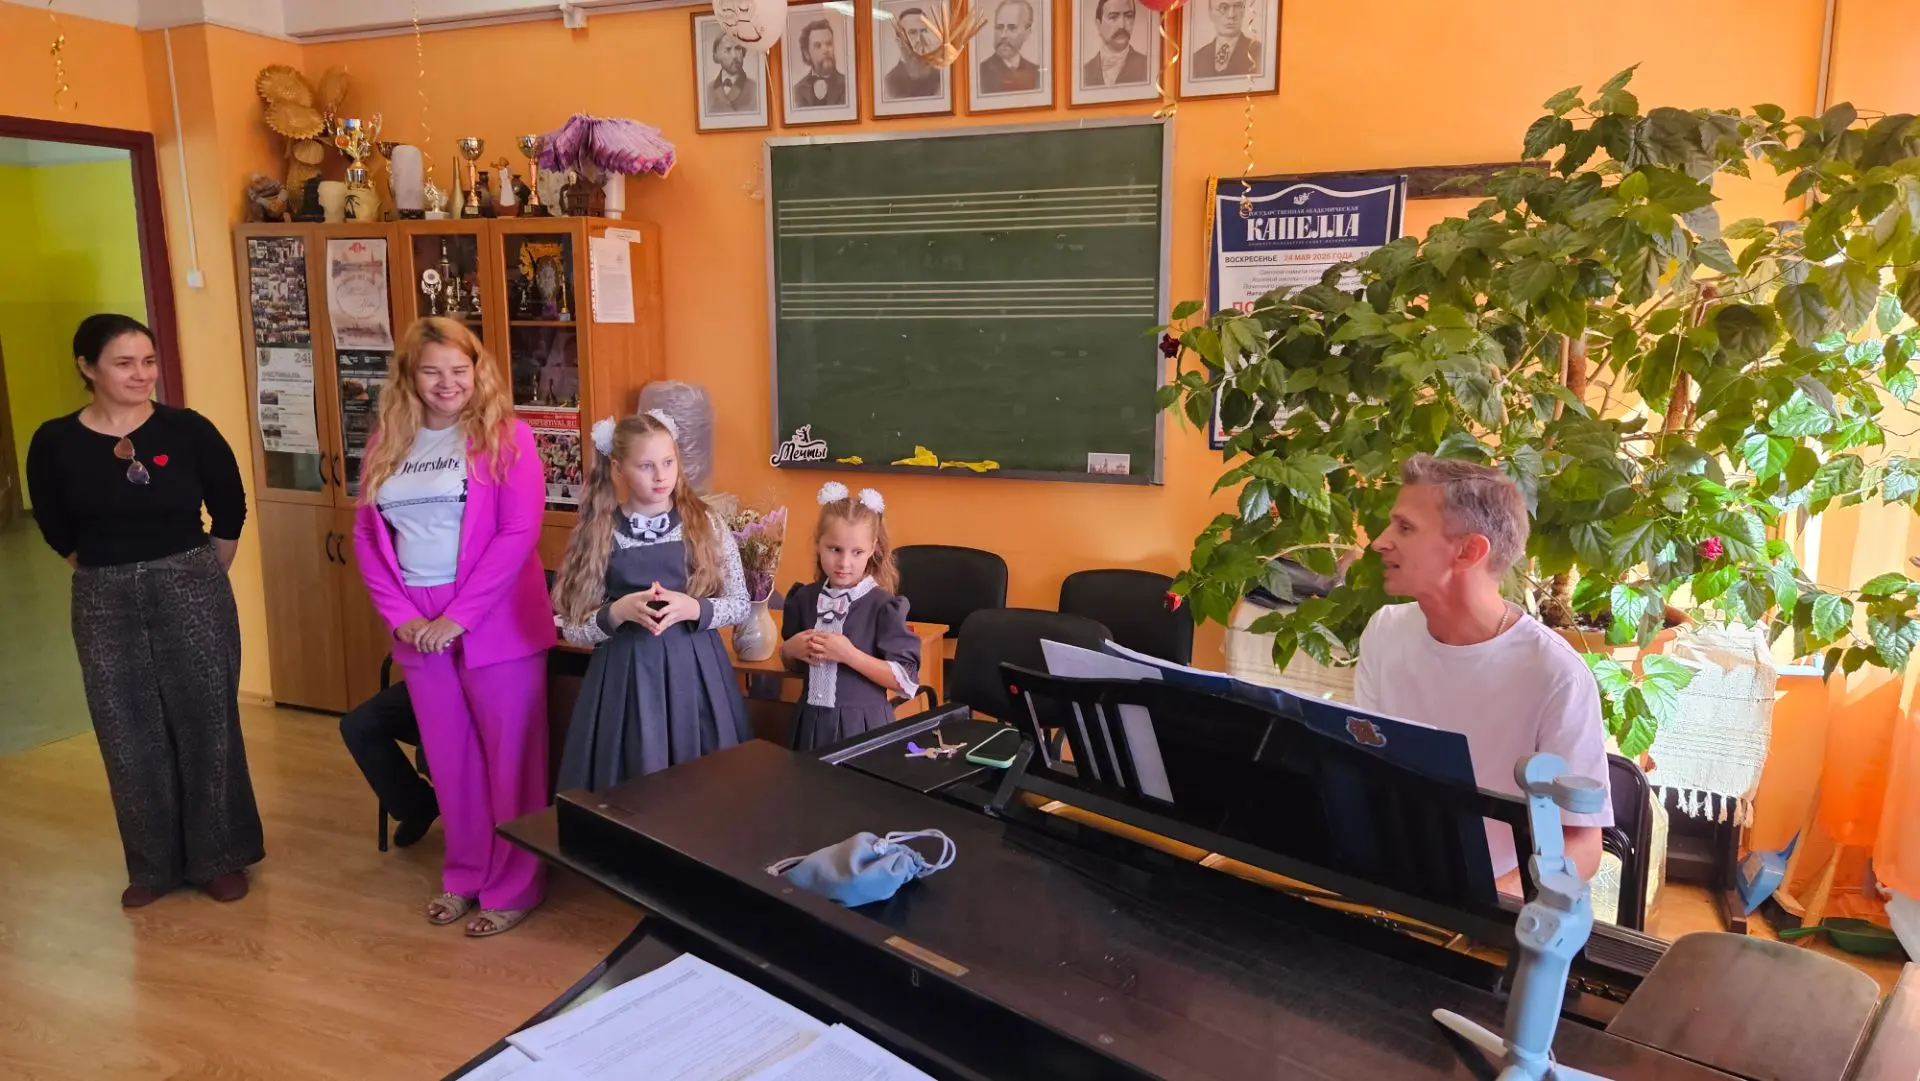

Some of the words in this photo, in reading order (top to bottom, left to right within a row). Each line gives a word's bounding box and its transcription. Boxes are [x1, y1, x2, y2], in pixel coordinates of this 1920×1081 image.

[1246, 213, 1360, 241] КАПЕЛЛА
[1225, 255, 1278, 263] ВОСКРЕСЕНЬЕ
[1294, 252, 1311, 261] МАЯ
[1332, 251, 1353, 260] ГОДА
[771, 442, 826, 465] Мечты
